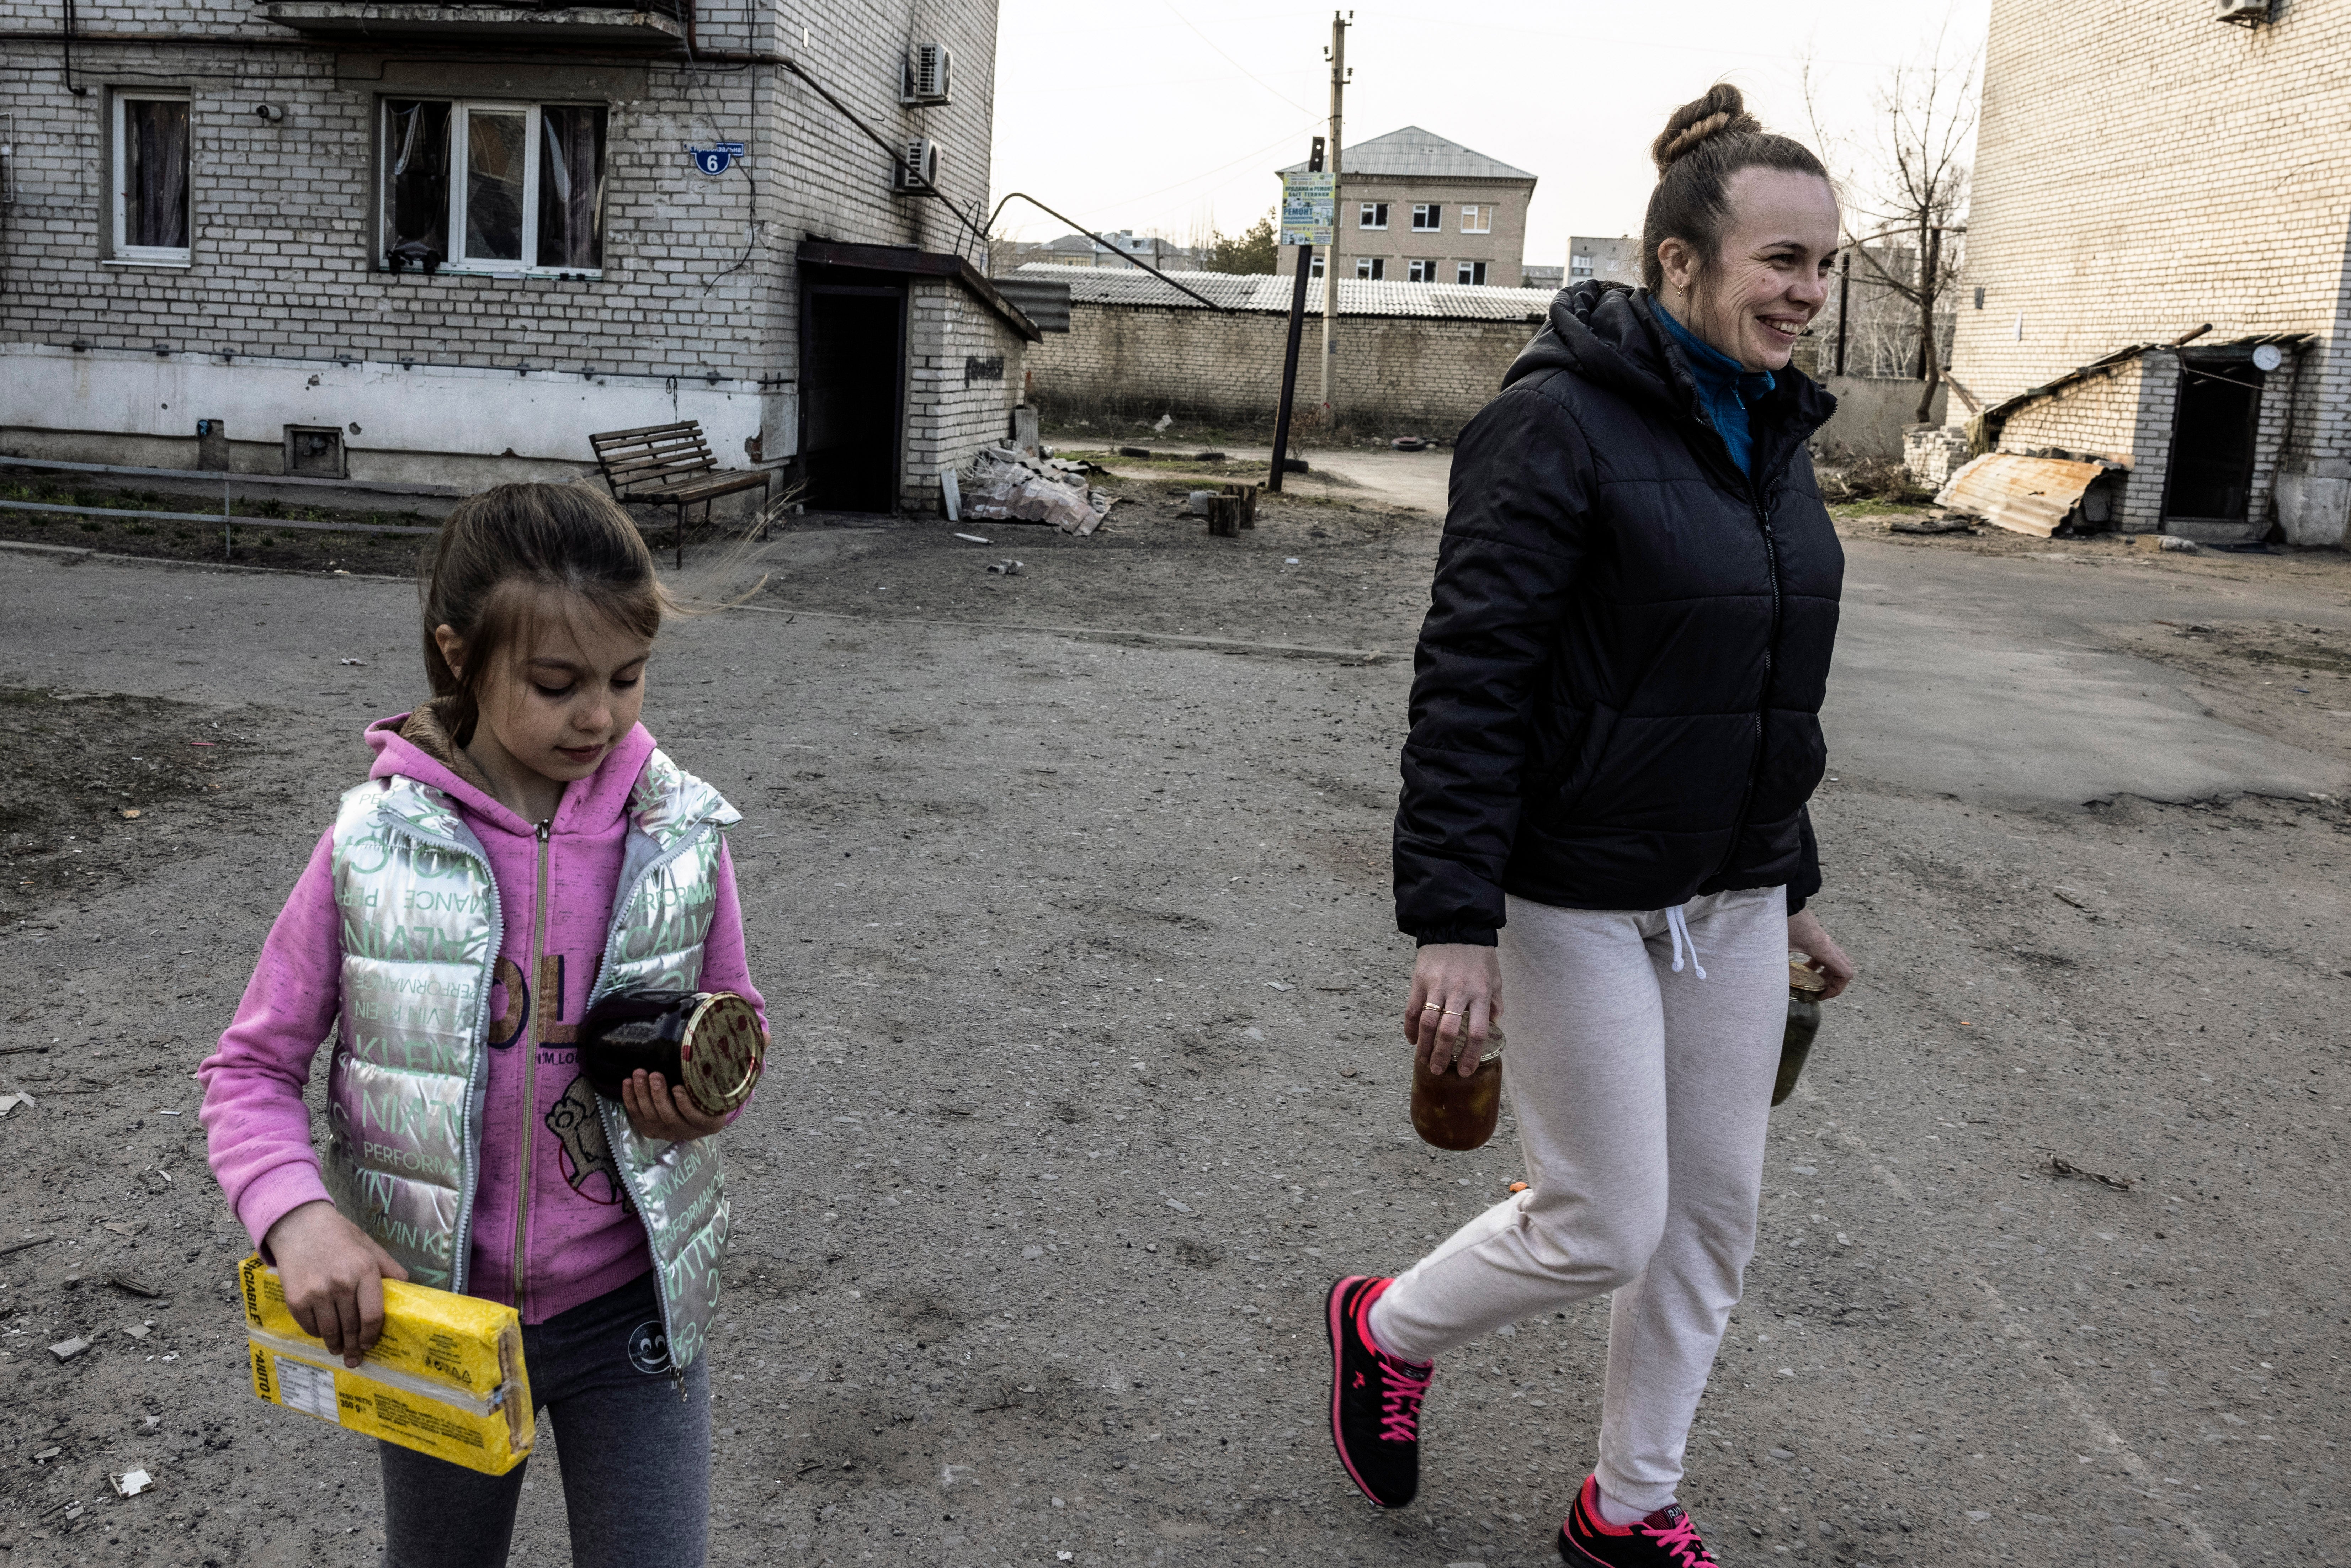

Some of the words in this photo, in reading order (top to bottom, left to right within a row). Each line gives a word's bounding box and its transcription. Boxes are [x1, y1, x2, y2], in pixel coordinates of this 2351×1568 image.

[707, 155, 718, 171] 6
[538, 1052, 554, 1065] I'M
[670, 1148, 701, 1190] KLEIN
[339, 1391, 353, 1400] PESO
[355, 1395, 372, 1406] NETTO
[340, 1399, 354, 1410] 350
